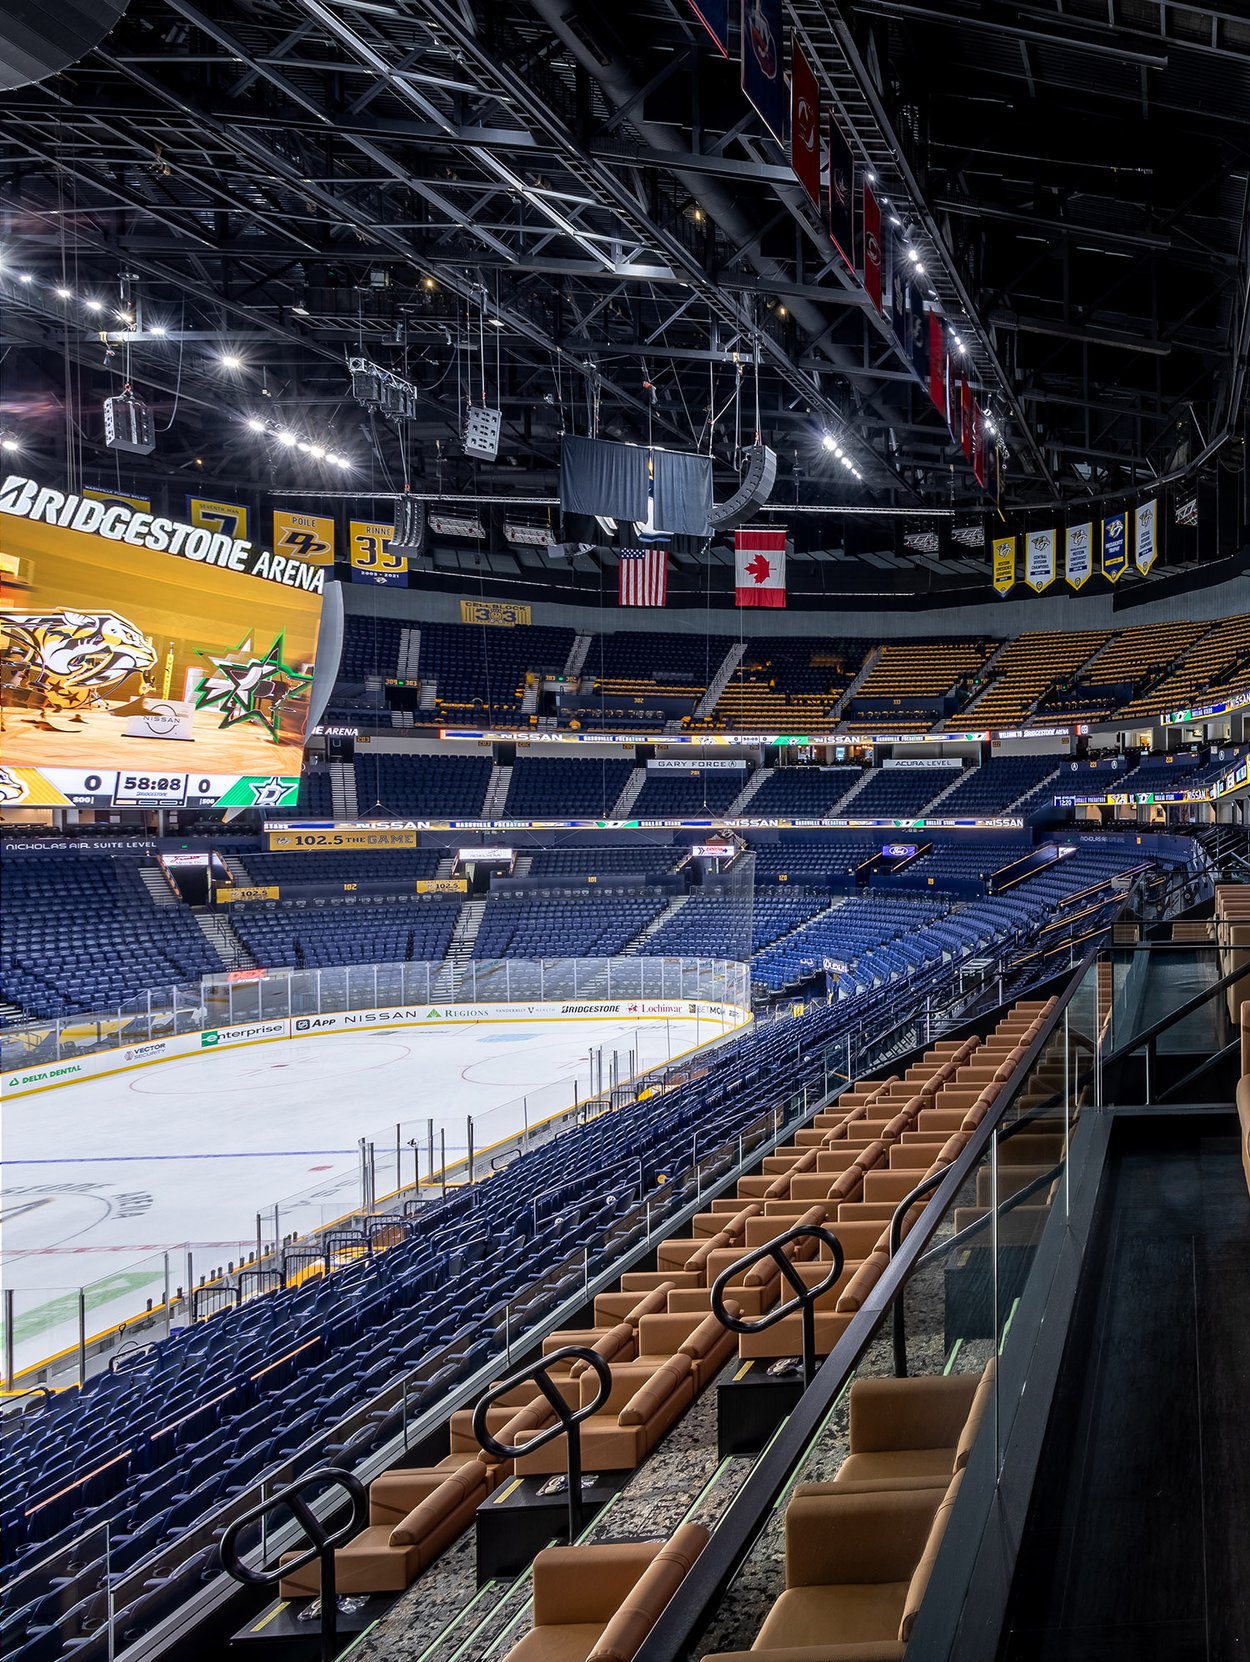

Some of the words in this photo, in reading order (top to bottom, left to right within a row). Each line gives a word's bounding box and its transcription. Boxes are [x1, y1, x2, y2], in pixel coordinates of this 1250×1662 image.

[291, 516, 317, 528] POILE
[0, 475, 252, 571] BRIDGESTONE
[251, 551, 325, 595] ARENA
[366, 526, 392, 536] RINNE
[465, 601, 527, 611] CELLBLOCK
[143, 715, 181, 724] NISSAN
[325, 728, 359, 736] ARENA
[500, 733, 563, 741] NISSAN
[814, 736, 860, 744] NISSAN
[84, 774, 103, 792] 0
[198, 778, 211, 794] 0
[355, 821, 431, 829] NISSAN
[985, 819, 1024, 827] NISSAN
[295, 835, 343, 846] 102.5
[367, 834, 414, 844] GAME
[344, 883, 358, 891] 102
[445, 1009, 489, 1017] REGIONS
[561, 1005, 620, 1014] BRIDGESTONE
[642, 1004, 683, 1013] Lochinvar
[344, 1011, 417, 1024] NISSAN
[312, 1018, 336, 1028] App
[134, 1043, 166, 1054] VECTOR
[134, 1048, 166, 1060] SECURITY
[22, 1073, 48, 1084] DELTA
[50, 1065, 82, 1079] DENTAL
